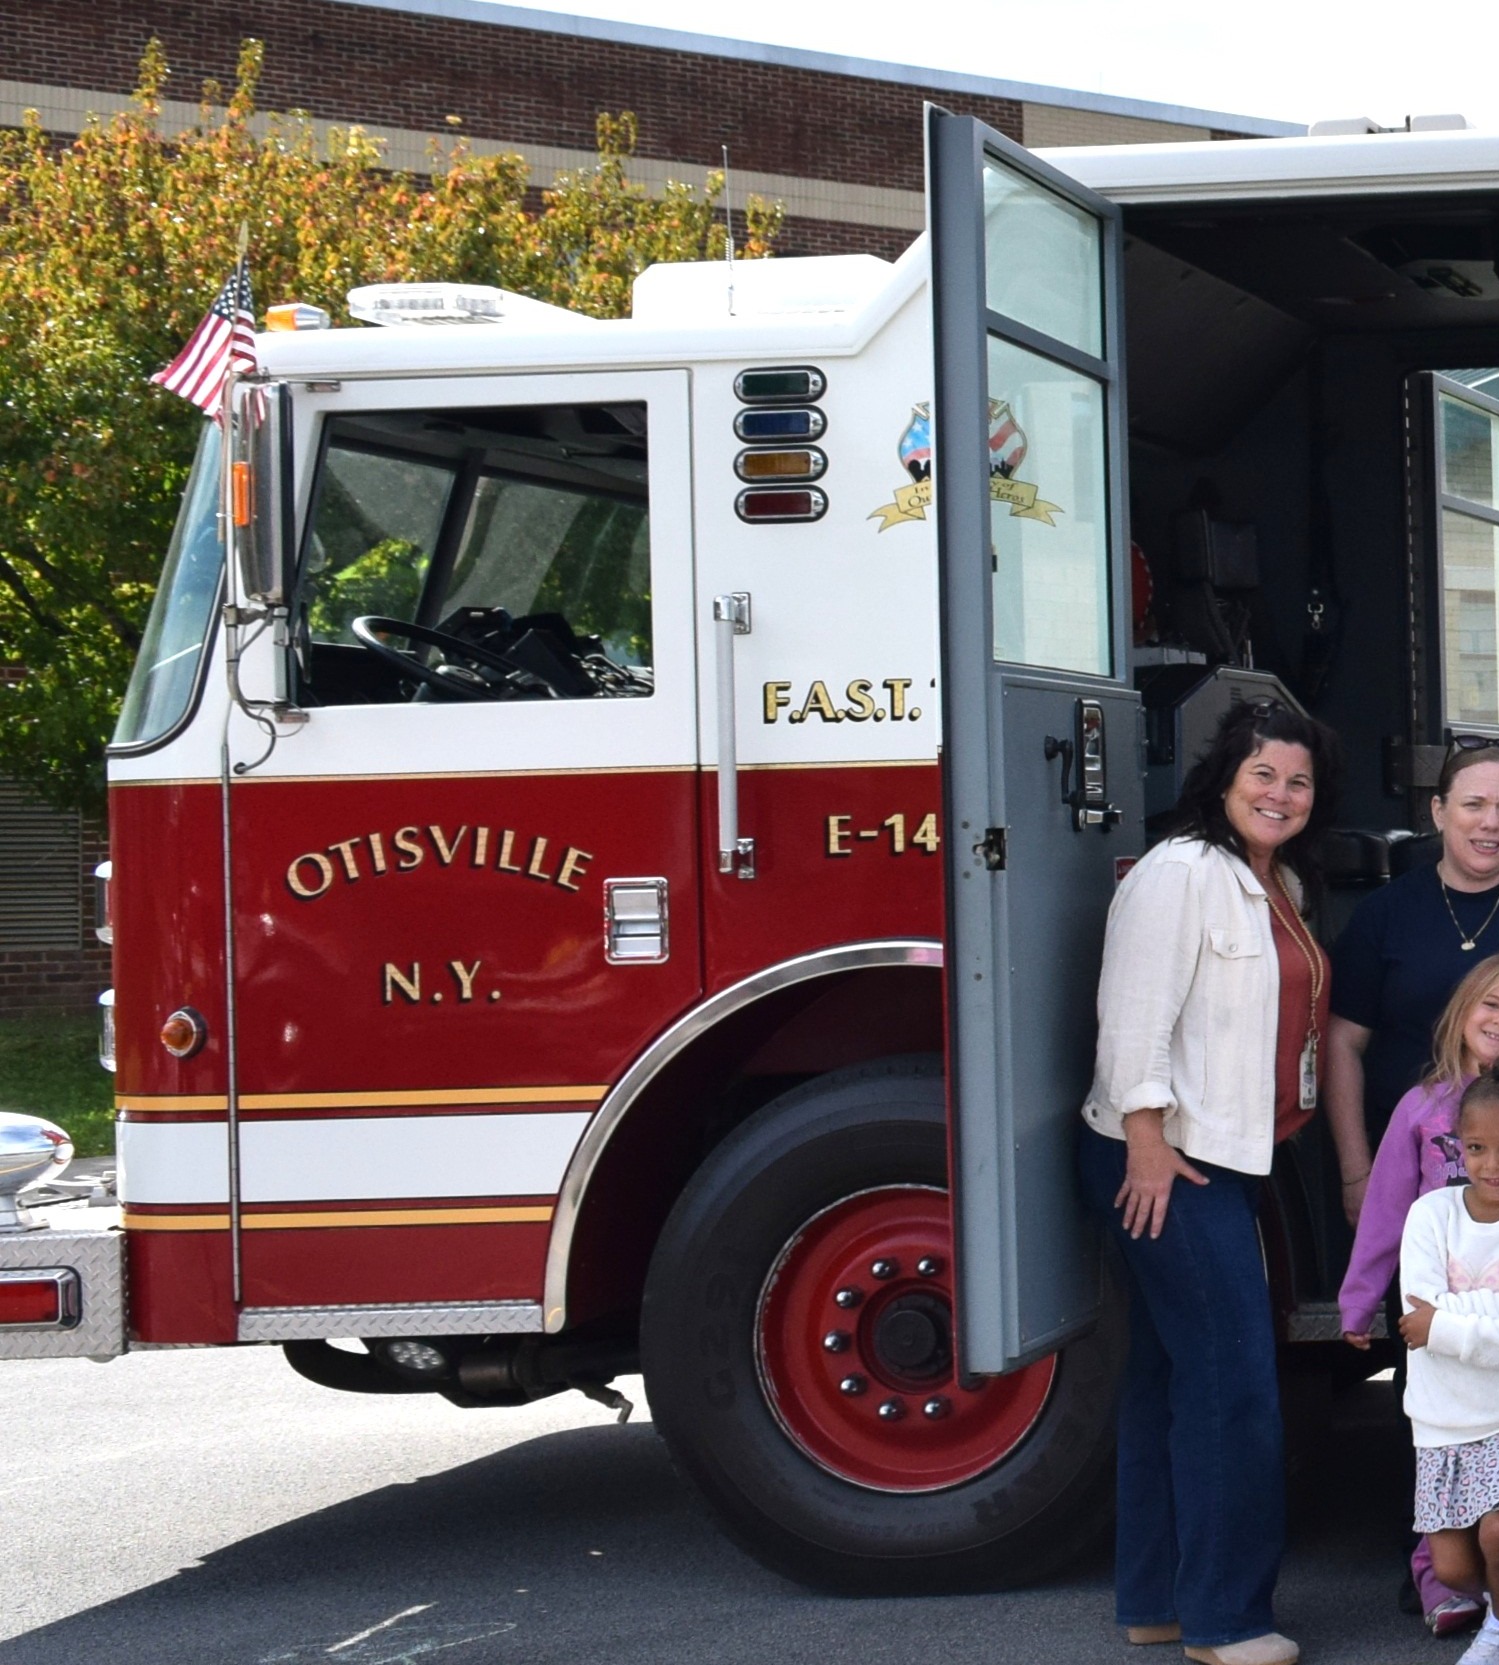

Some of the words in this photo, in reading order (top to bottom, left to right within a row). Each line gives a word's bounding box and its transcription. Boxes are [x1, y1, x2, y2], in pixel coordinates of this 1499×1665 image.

[763, 678, 922, 724] F.A.S.T.
[826, 813, 941, 858] E-14
[286, 825, 593, 900] OTISVILLE
[382, 961, 502, 1005] N.Y.
